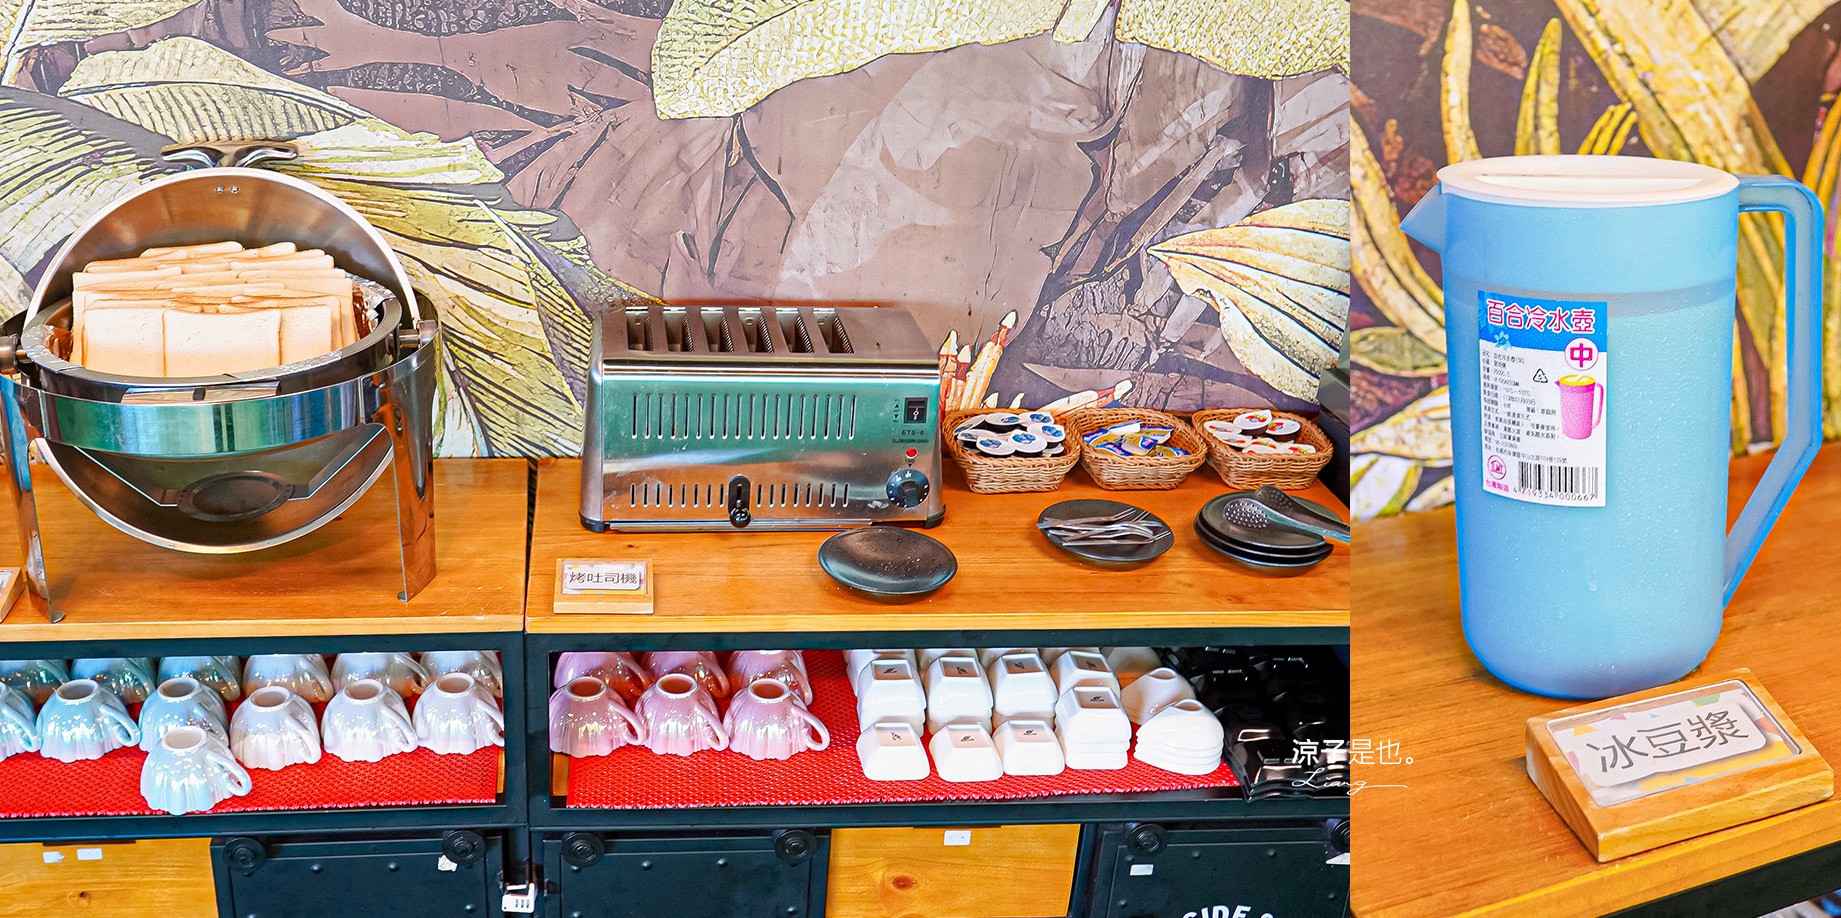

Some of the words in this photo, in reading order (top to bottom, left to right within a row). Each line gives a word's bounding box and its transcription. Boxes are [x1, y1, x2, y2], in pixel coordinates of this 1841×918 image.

[1487, 299, 1595, 333] 百合冷水壺
[1569, 342, 1593, 368] 中
[569, 572, 638, 584] 烤吐司機
[1586, 710, 1749, 773] 冰豆漿
